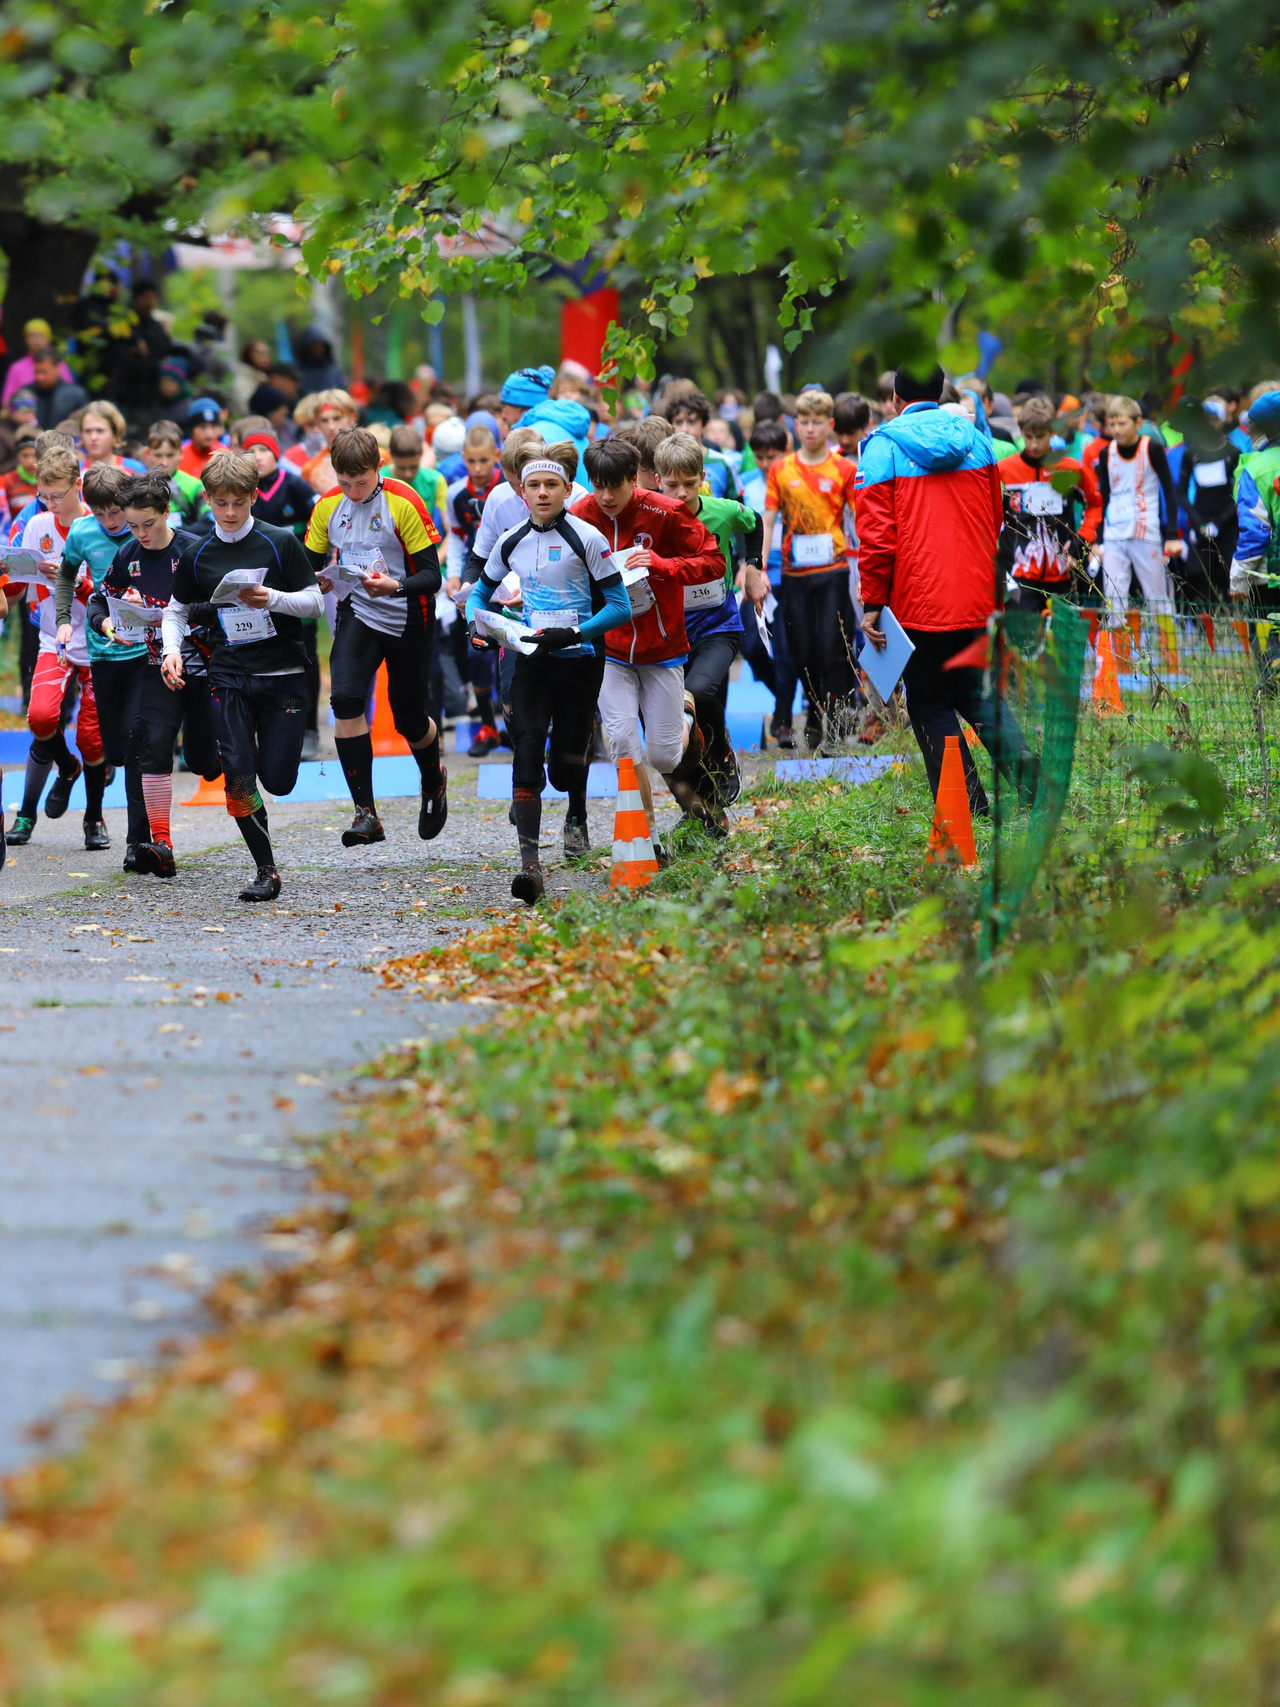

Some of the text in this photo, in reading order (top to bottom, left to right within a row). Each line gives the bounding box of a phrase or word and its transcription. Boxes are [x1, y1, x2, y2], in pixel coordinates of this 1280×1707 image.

[526, 462, 561, 472] noname
[692, 587, 710, 598] 236
[235, 622, 253, 632] 229
